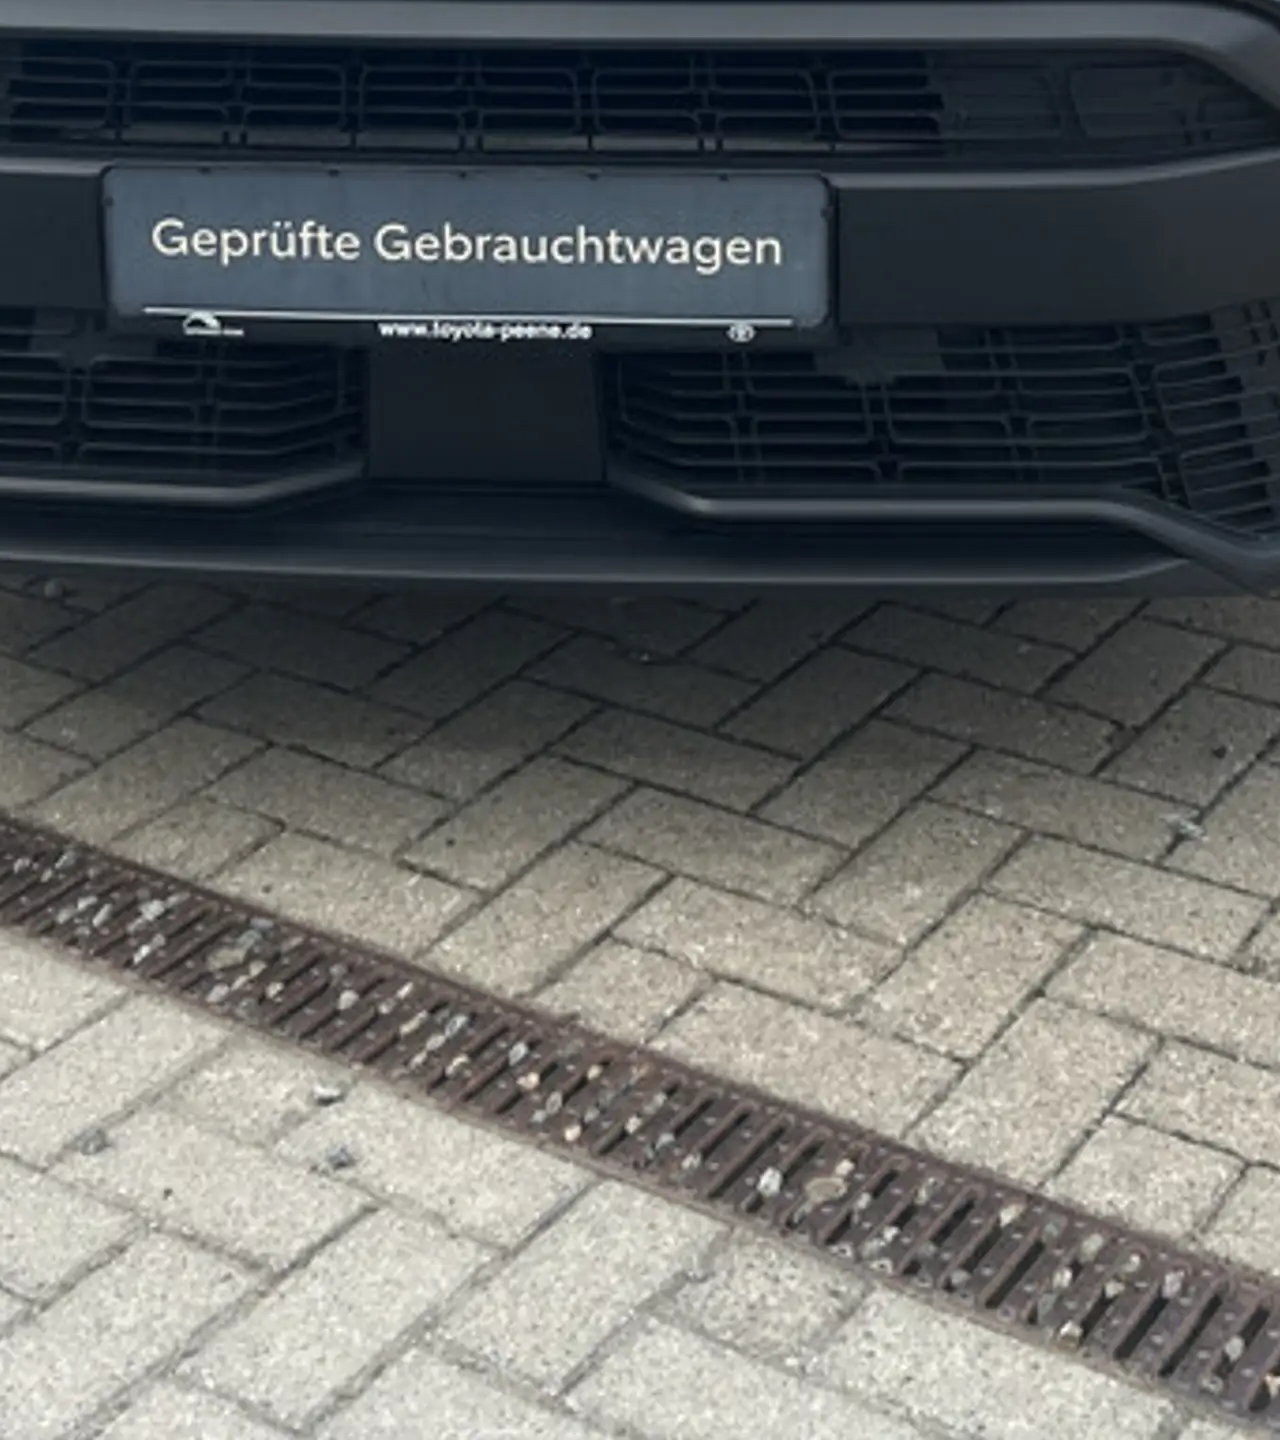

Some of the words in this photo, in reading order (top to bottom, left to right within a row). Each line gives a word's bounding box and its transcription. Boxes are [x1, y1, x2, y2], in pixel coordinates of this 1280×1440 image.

[151, 217, 361, 267] Geprüfte
[373, 222, 783, 275] Gebrauchtwagen
[378, 322, 593, 342] www.toyota-peene.de
